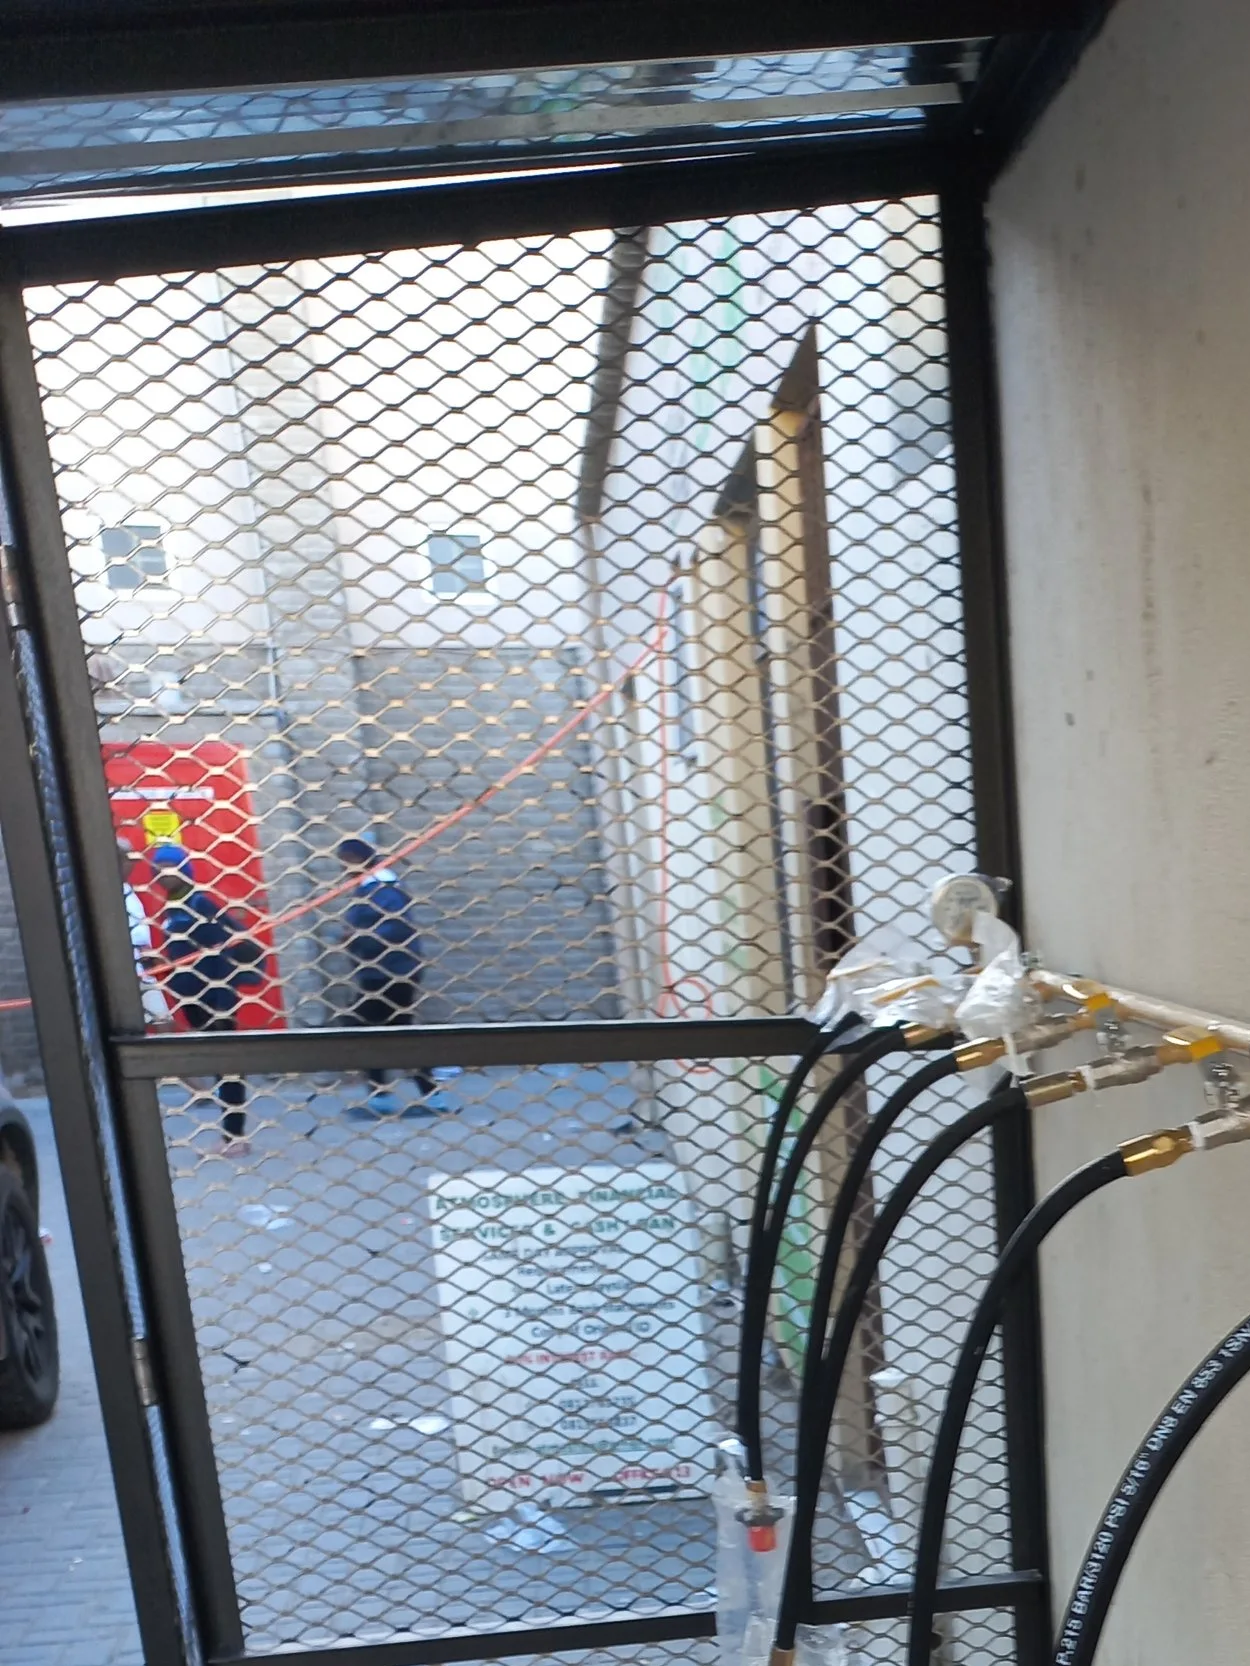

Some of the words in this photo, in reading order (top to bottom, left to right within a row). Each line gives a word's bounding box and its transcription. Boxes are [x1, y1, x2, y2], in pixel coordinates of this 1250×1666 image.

[1104, 1498, 1131, 1530] PSI
[1171, 1389, 1199, 1415] EN
[1191, 1359, 1224, 1389] 853
